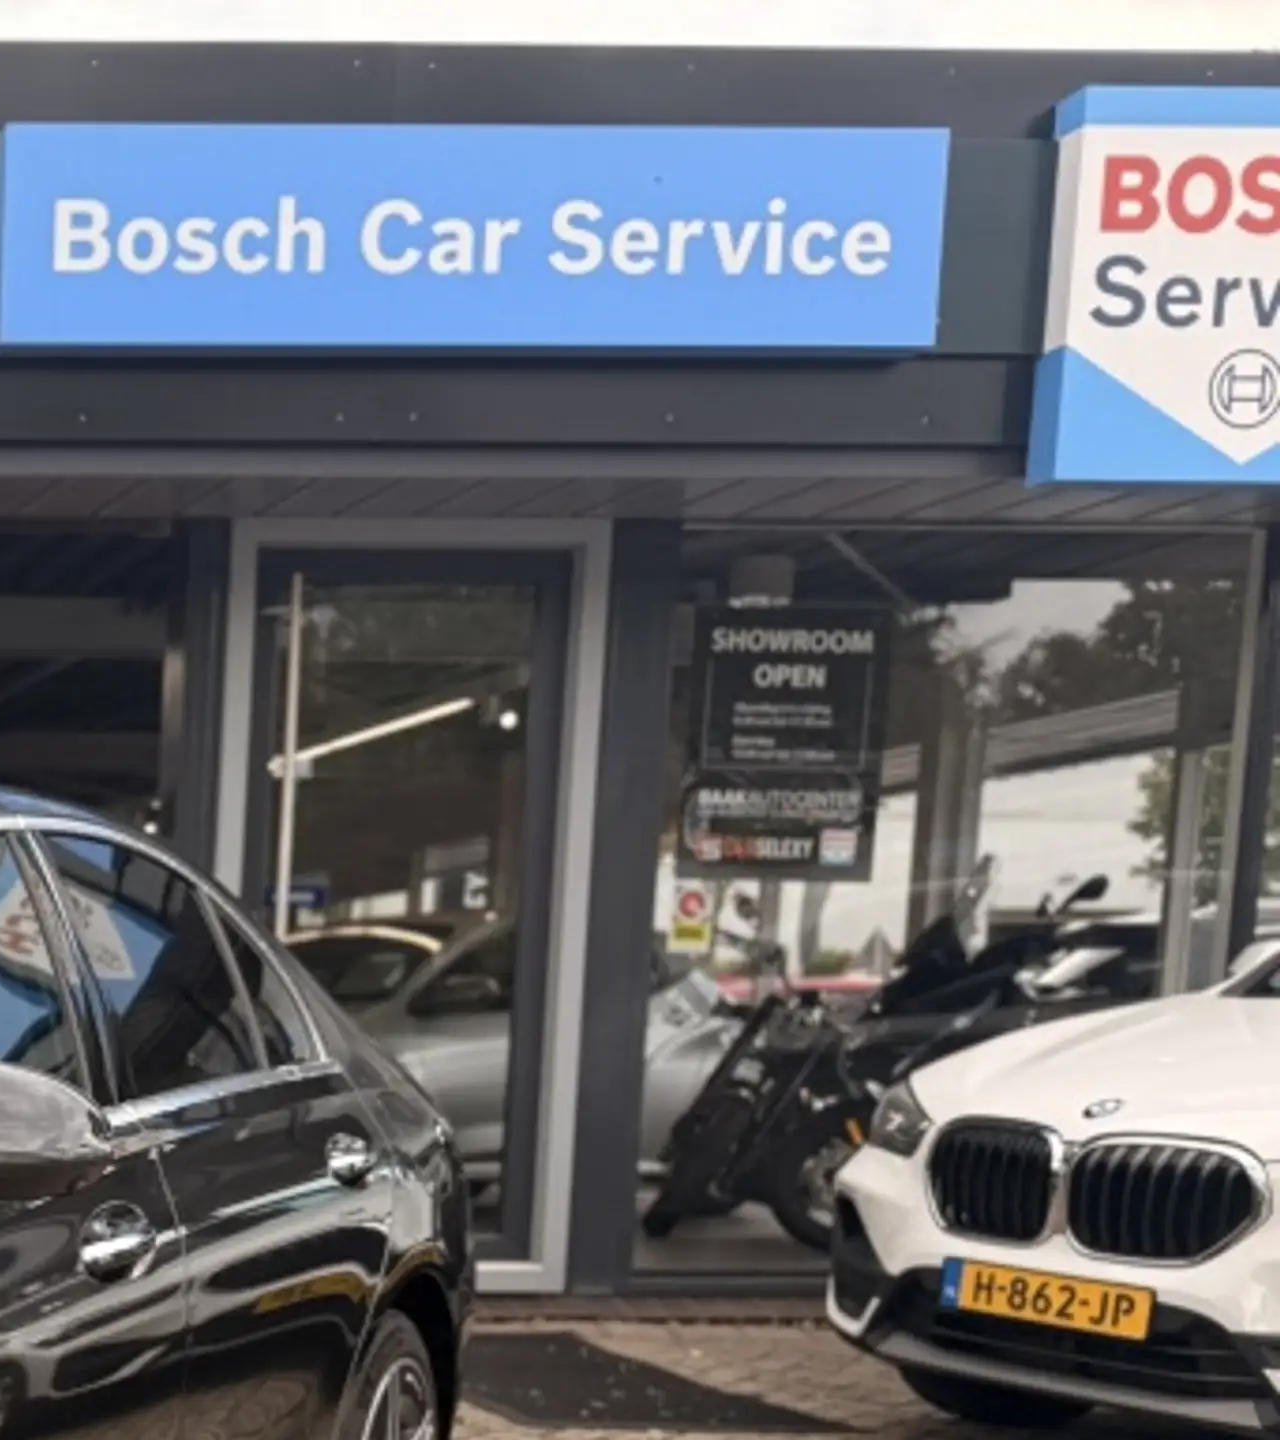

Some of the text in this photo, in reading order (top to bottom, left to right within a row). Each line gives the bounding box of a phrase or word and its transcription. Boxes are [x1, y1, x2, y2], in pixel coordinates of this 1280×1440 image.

[52, 197, 892, 275] Bosch Car Service
[711, 627, 874, 655] SHOWROOM
[753, 663, 827, 689] OPEN
[972, 1271, 1135, 1328] H-862-JP
